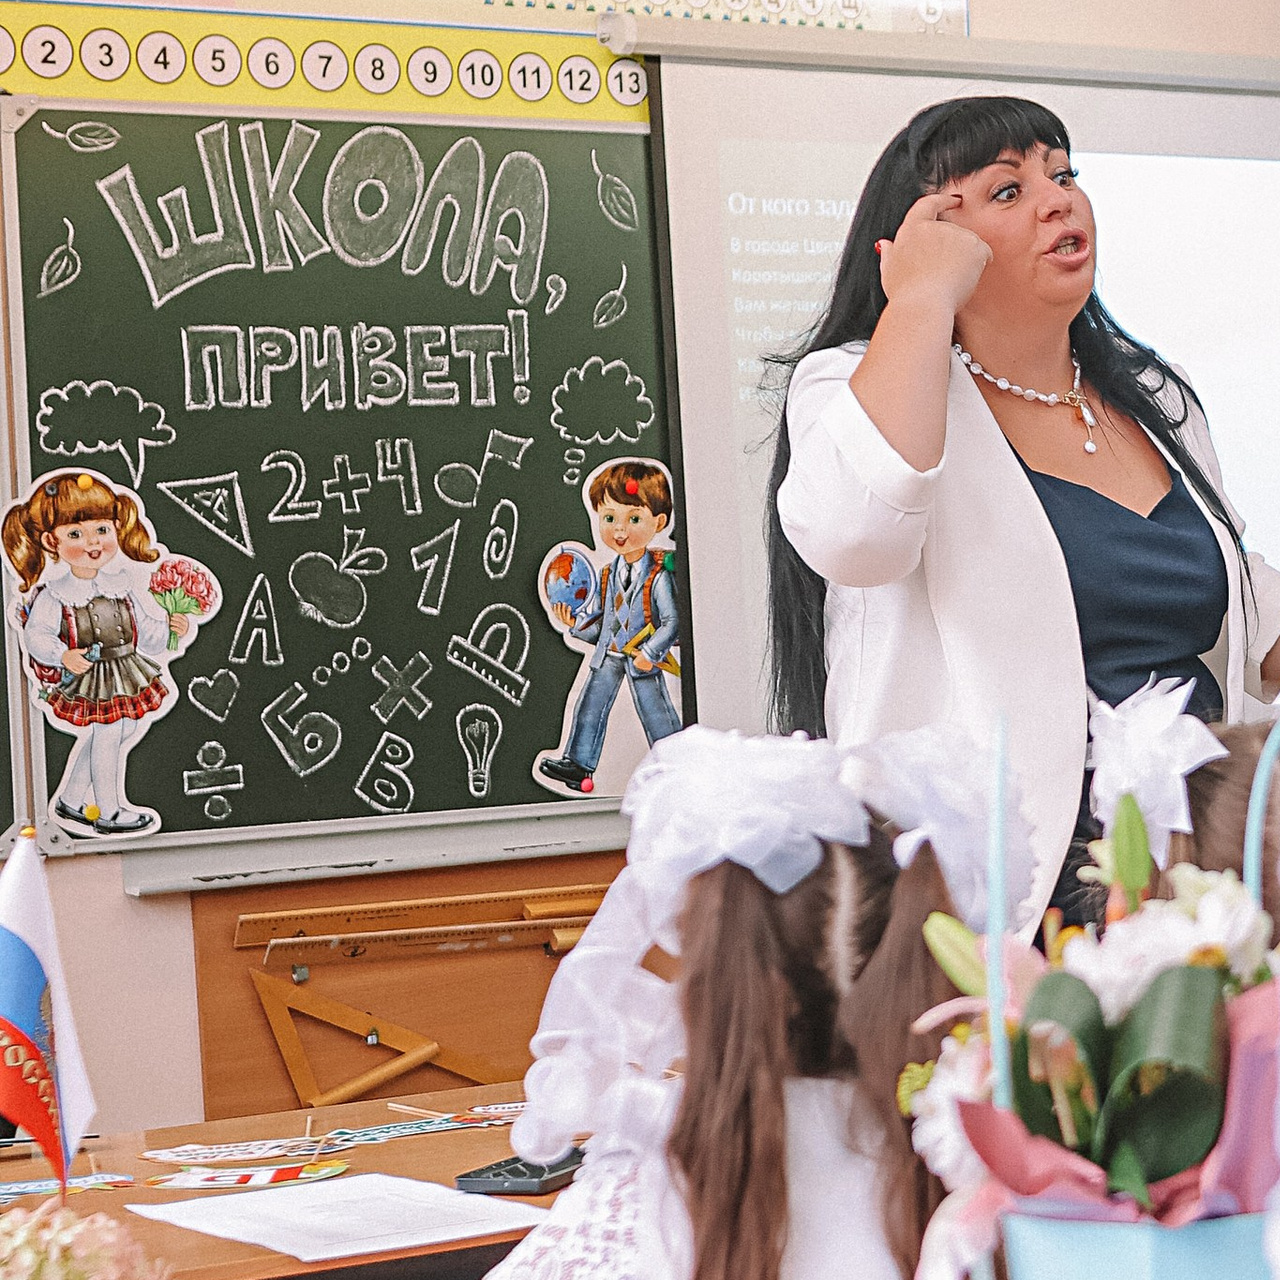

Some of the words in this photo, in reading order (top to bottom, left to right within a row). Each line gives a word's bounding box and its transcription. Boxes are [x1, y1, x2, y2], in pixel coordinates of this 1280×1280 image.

[40, 39, 57, 65] 2
[98, 42, 114, 67] 3
[153, 45, 170, 70] 4
[210, 48, 226, 73] 5
[264, 51, 280, 76] 6
[318, 54, 333, 78] 7
[370, 57, 386, 81] 8
[423, 60, 438, 84] 9
[465, 62, 494, 87] 10
[517, 65, 542, 90] 11
[563, 67, 592, 92] 12
[613, 70, 641, 95] 13
[95, 118, 567, 314] ШКОЛА,
[728, 191, 756, 216] От
[761, 195, 811, 217] кого
[180, 308, 530, 412] ПРИВЕТ!
[228, 572, 285, 665] А
